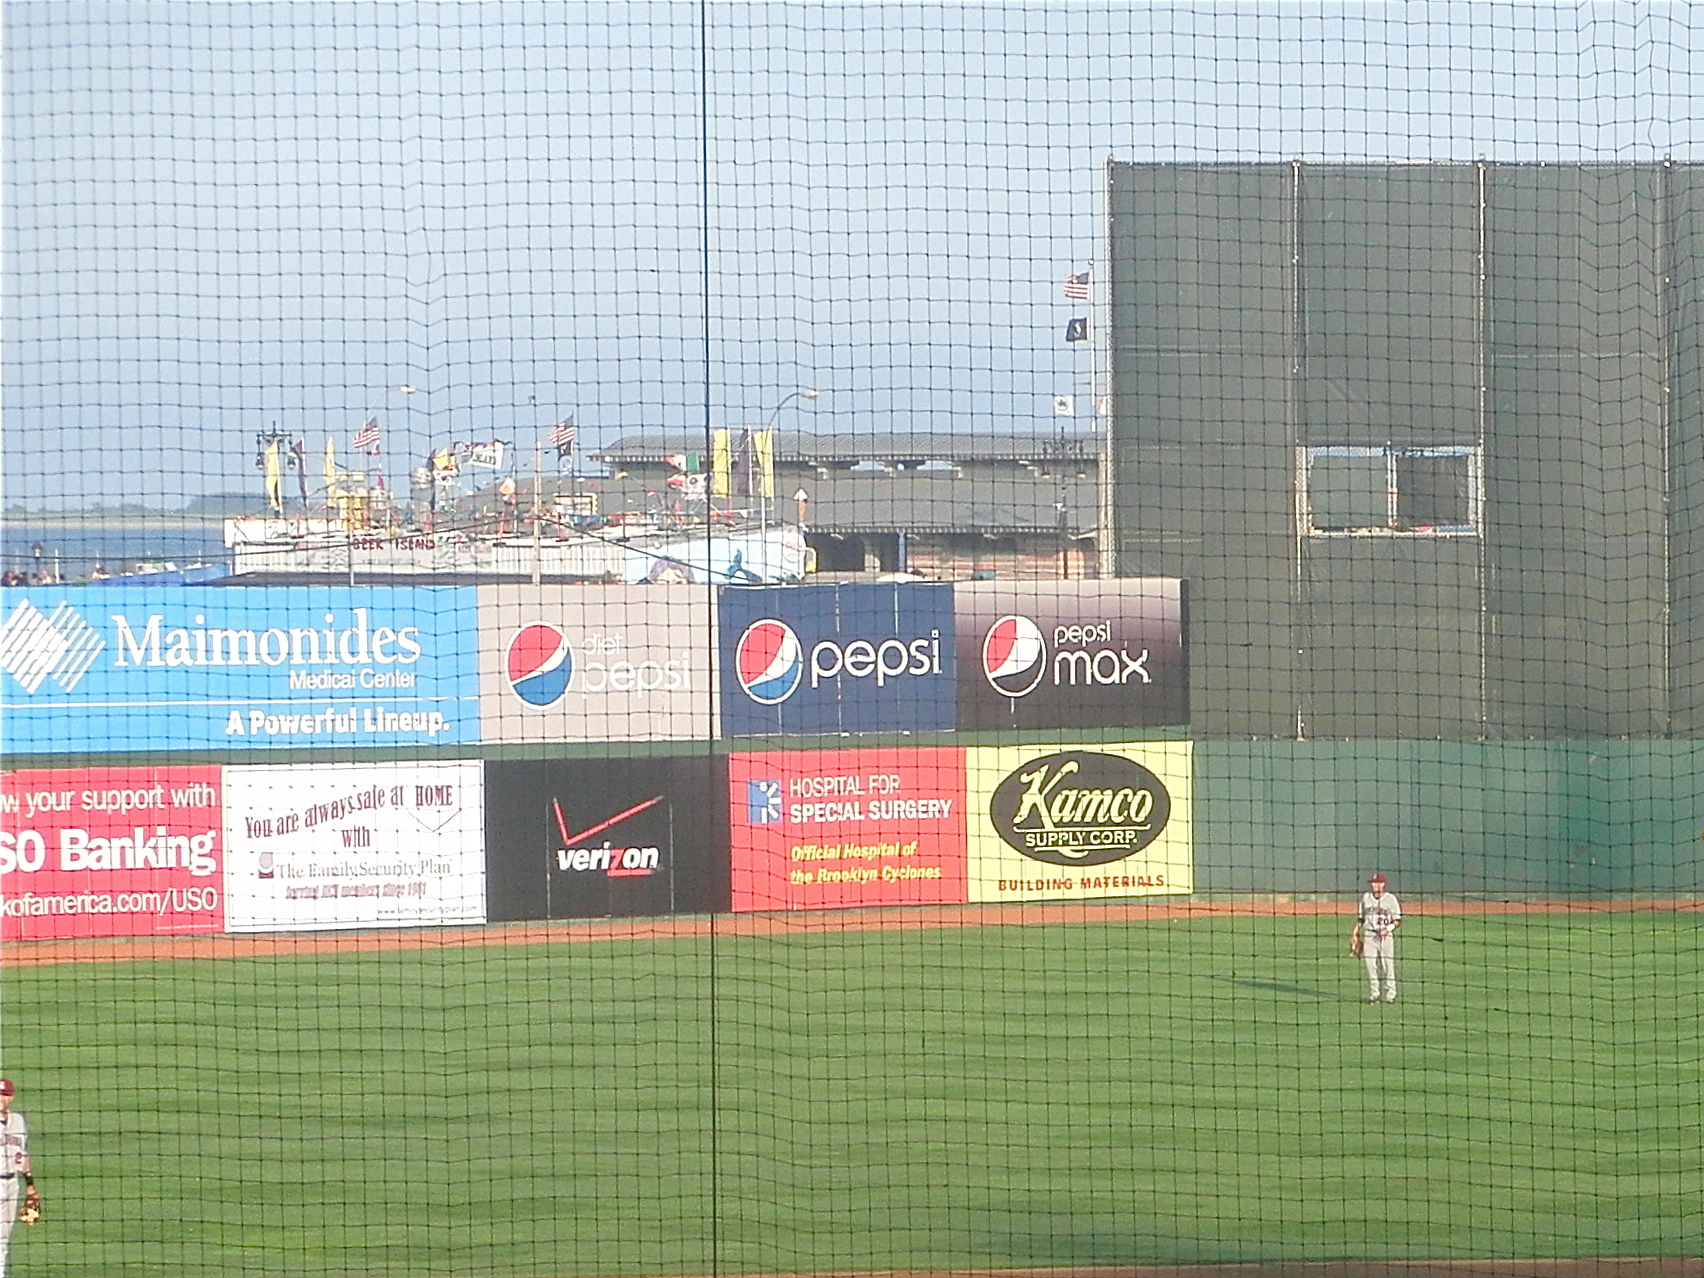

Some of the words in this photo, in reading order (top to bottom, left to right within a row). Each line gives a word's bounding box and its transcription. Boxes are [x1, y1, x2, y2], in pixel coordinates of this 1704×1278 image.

[112, 608, 422, 667] Maimonides
[582, 632, 624, 656] diet
[1054, 620, 1111, 648] pepsi
[811, 629, 941, 689] pepsi
[1054, 648, 1149, 686] max
[289, 669, 356, 690] Medical
[360, 668, 417, 689] Center
[581, 651, 690, 699] pepsi
[226, 711, 245, 735] A
[249, 707, 357, 735] Powerful
[363, 708, 450, 736] Lineup.
[26, 790, 75, 818] your
[81, 784, 165, 815] support
[171, 782, 215, 808] with
[789, 775, 866, 798] HOSPITAL
[868, 774, 901, 795] FOR
[1013, 760, 1153, 831] Kamco
[245, 816, 273, 839] You
[276, 813, 300, 836] are
[304, 795, 354, 828] always
[415, 785, 454, 807] HOME
[790, 801, 866, 824] SPECIAL
[868, 799, 953, 821] SURGERY
[60, 826, 217, 876] Banking
[341, 826, 371, 848] with
[791, 843, 842, 862] Official
[843, 842, 901, 861] Hospital
[902, 840, 918, 857] of
[1025, 831, 1086, 847] SUPPLY
[1089, 829, 1138, 846] CORP.
[276, 863, 303, 878] The
[308, 862, 356, 880] Family
[358, 861, 416, 879] Security
[420, 858, 451, 875] Plan
[557, 841, 660, 877] verizon
[790, 870, 813, 885] the
[817, 867, 878, 885] Brooklyn
[882, 864, 941, 884] Cyclones
[998, 878, 1074, 892] BUILDING
[1080, 874, 1165, 889] MATERIALS
